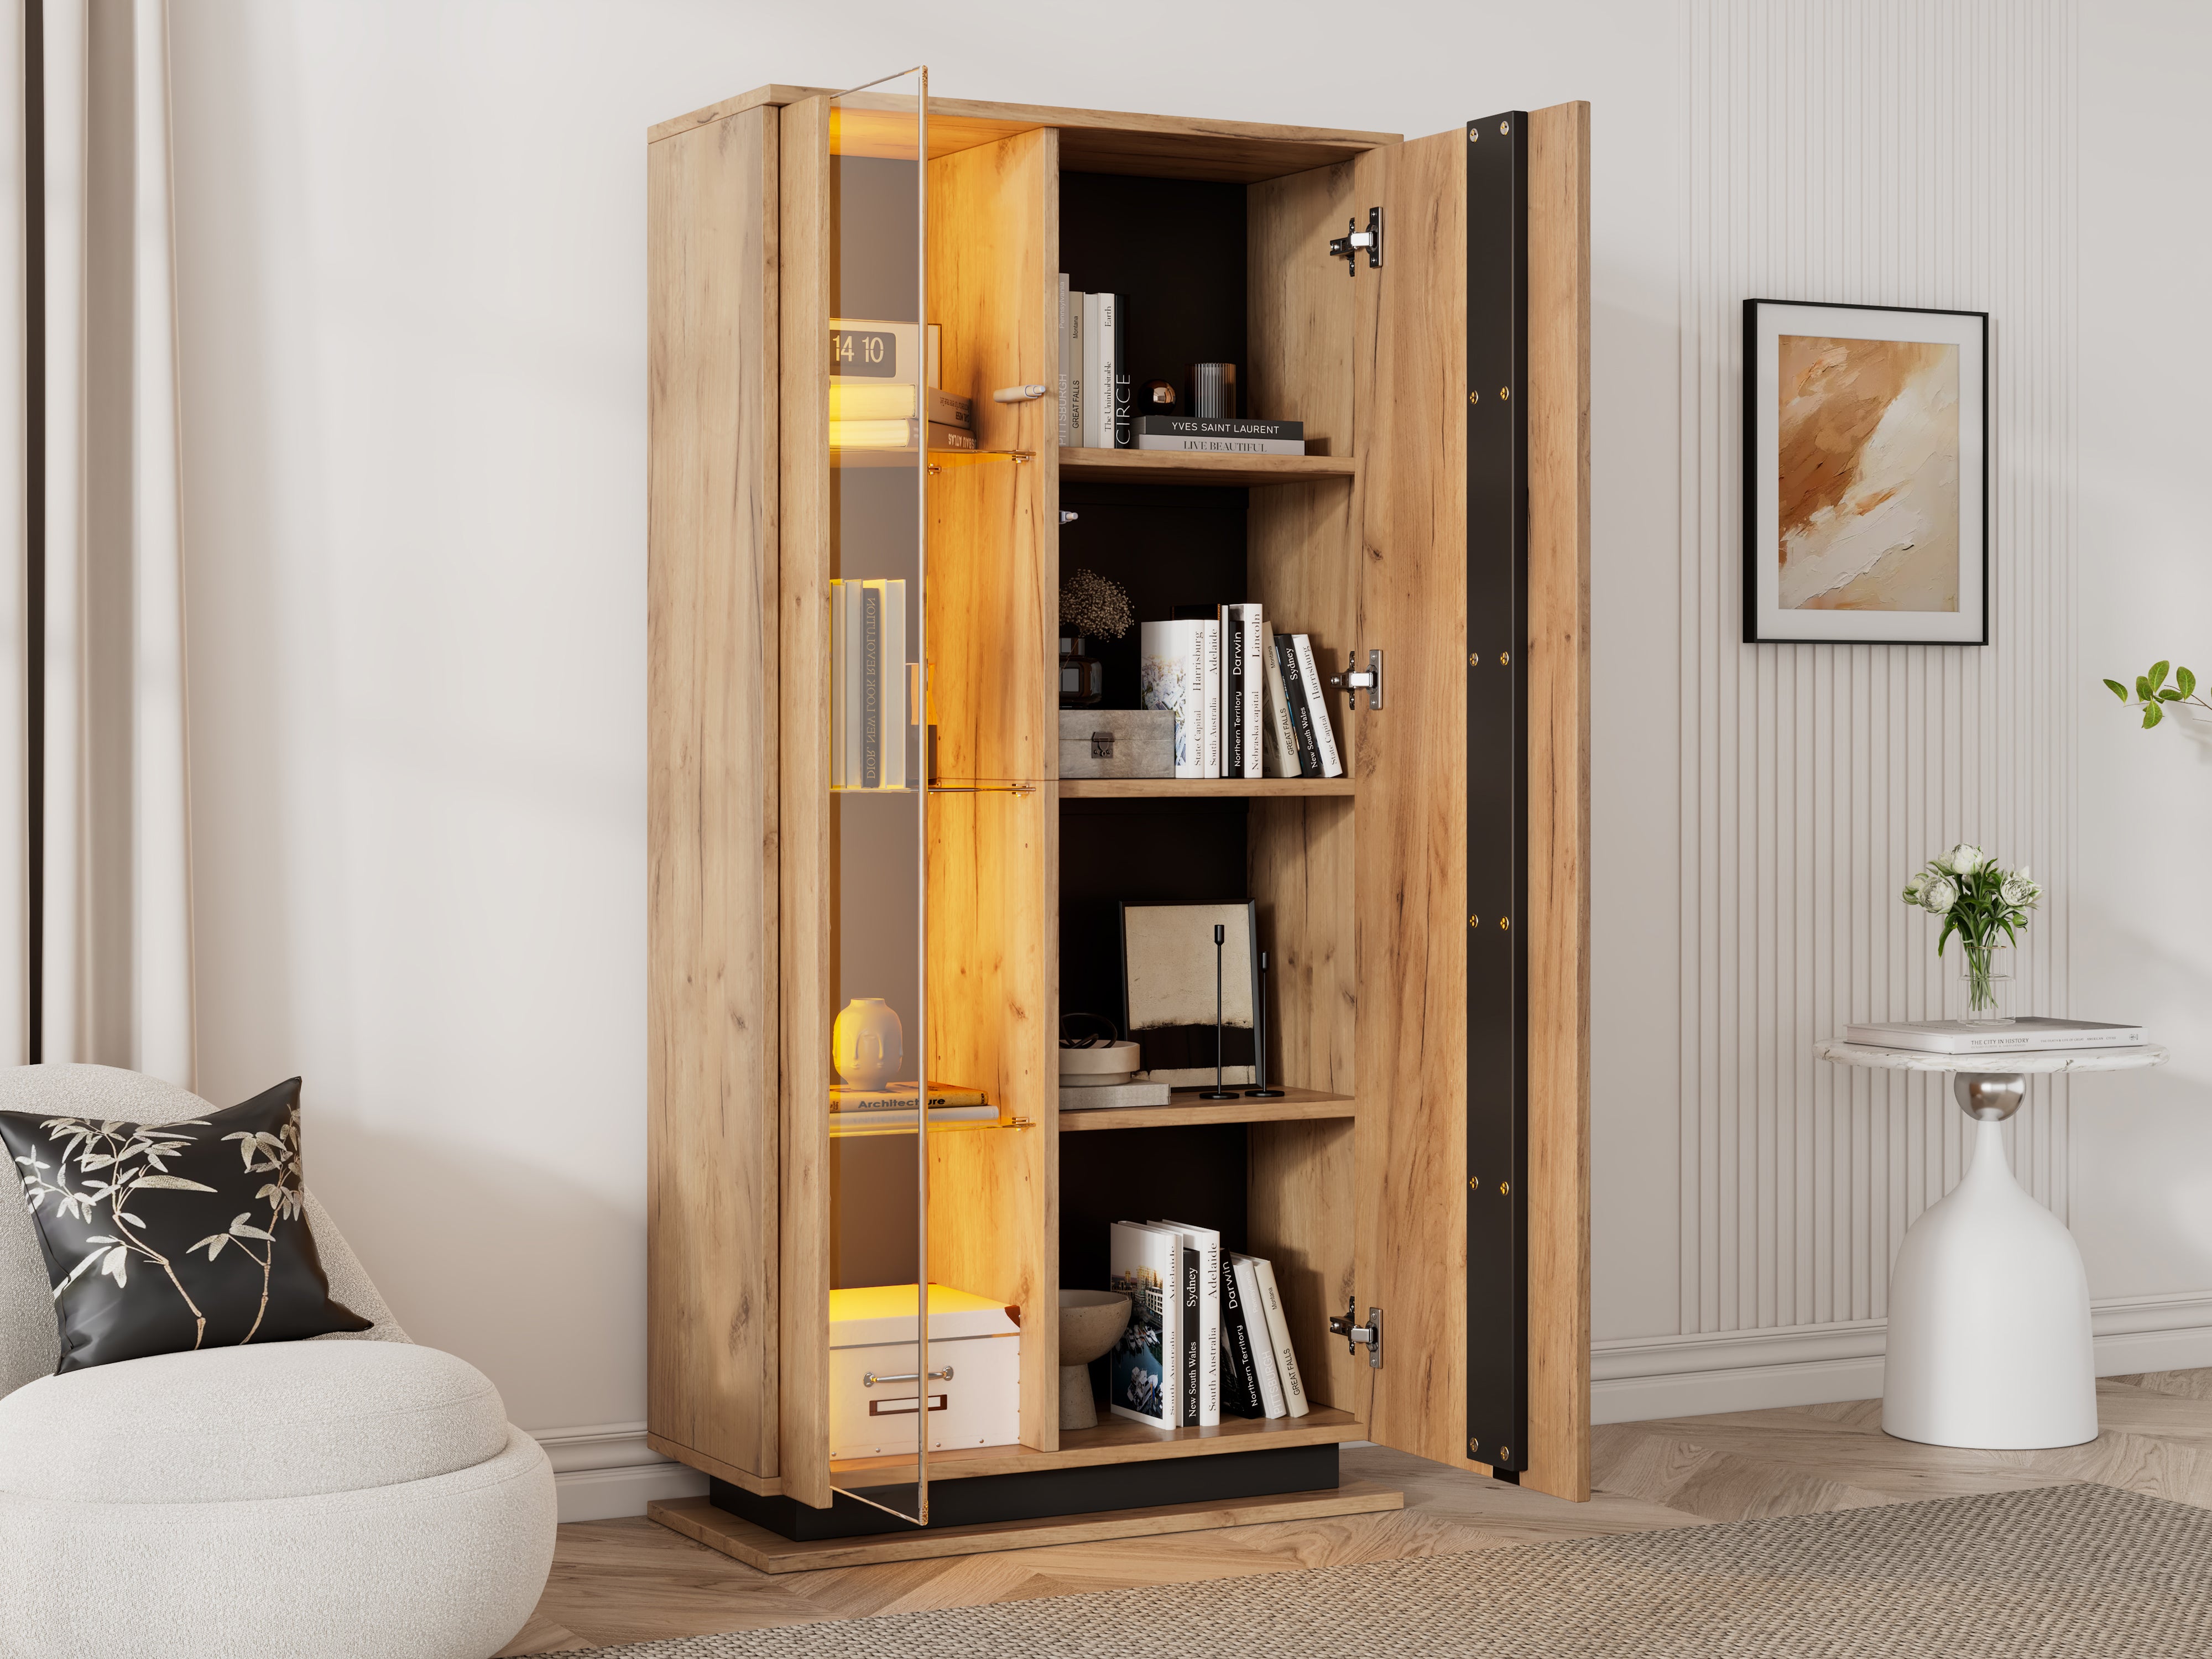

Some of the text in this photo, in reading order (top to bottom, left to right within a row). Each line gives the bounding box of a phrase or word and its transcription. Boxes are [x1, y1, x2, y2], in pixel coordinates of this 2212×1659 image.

[833, 335, 884, 363] 14 10
[1116, 374, 1130, 445] CIRCE
[1172, 422, 1279, 434] YVES SAINT LAURENT
[948, 433, 962, 447] ATLAS
[1183, 441, 1267, 452] LIVE BEAUTIFUL
[1192, 631, 1203, 691] Harrisburg
[1209, 629, 1217, 675] Adelaide
[1233, 632, 1241, 675] Darwin
[1286, 648, 1298, 681] Sydney
[1303, 645, 1321, 700] Harrisburg
[1194, 711, 1203, 741] Capital
[1252, 691, 1261, 722] capital
[1300, 707, 1309, 729] Wales
[1280, 708, 1295, 755] GREAT FALLS
[1305, 729, 1314, 750] South
[1319, 716, 1337, 765] State Capital
[1187, 1267, 1198, 1307] Sydney
[1208, 1243, 1217, 1299] Adelaide
[1223, 1261, 1238, 1310] Darwin
[1268, 1287, 1277, 1310] Montana
[1237, 1325, 1258, 1407] Northern Territory
[1261, 1350, 1283, 1415] PITTSBURGH
[1284, 1348, 1300, 1396] GREAT FALLS
